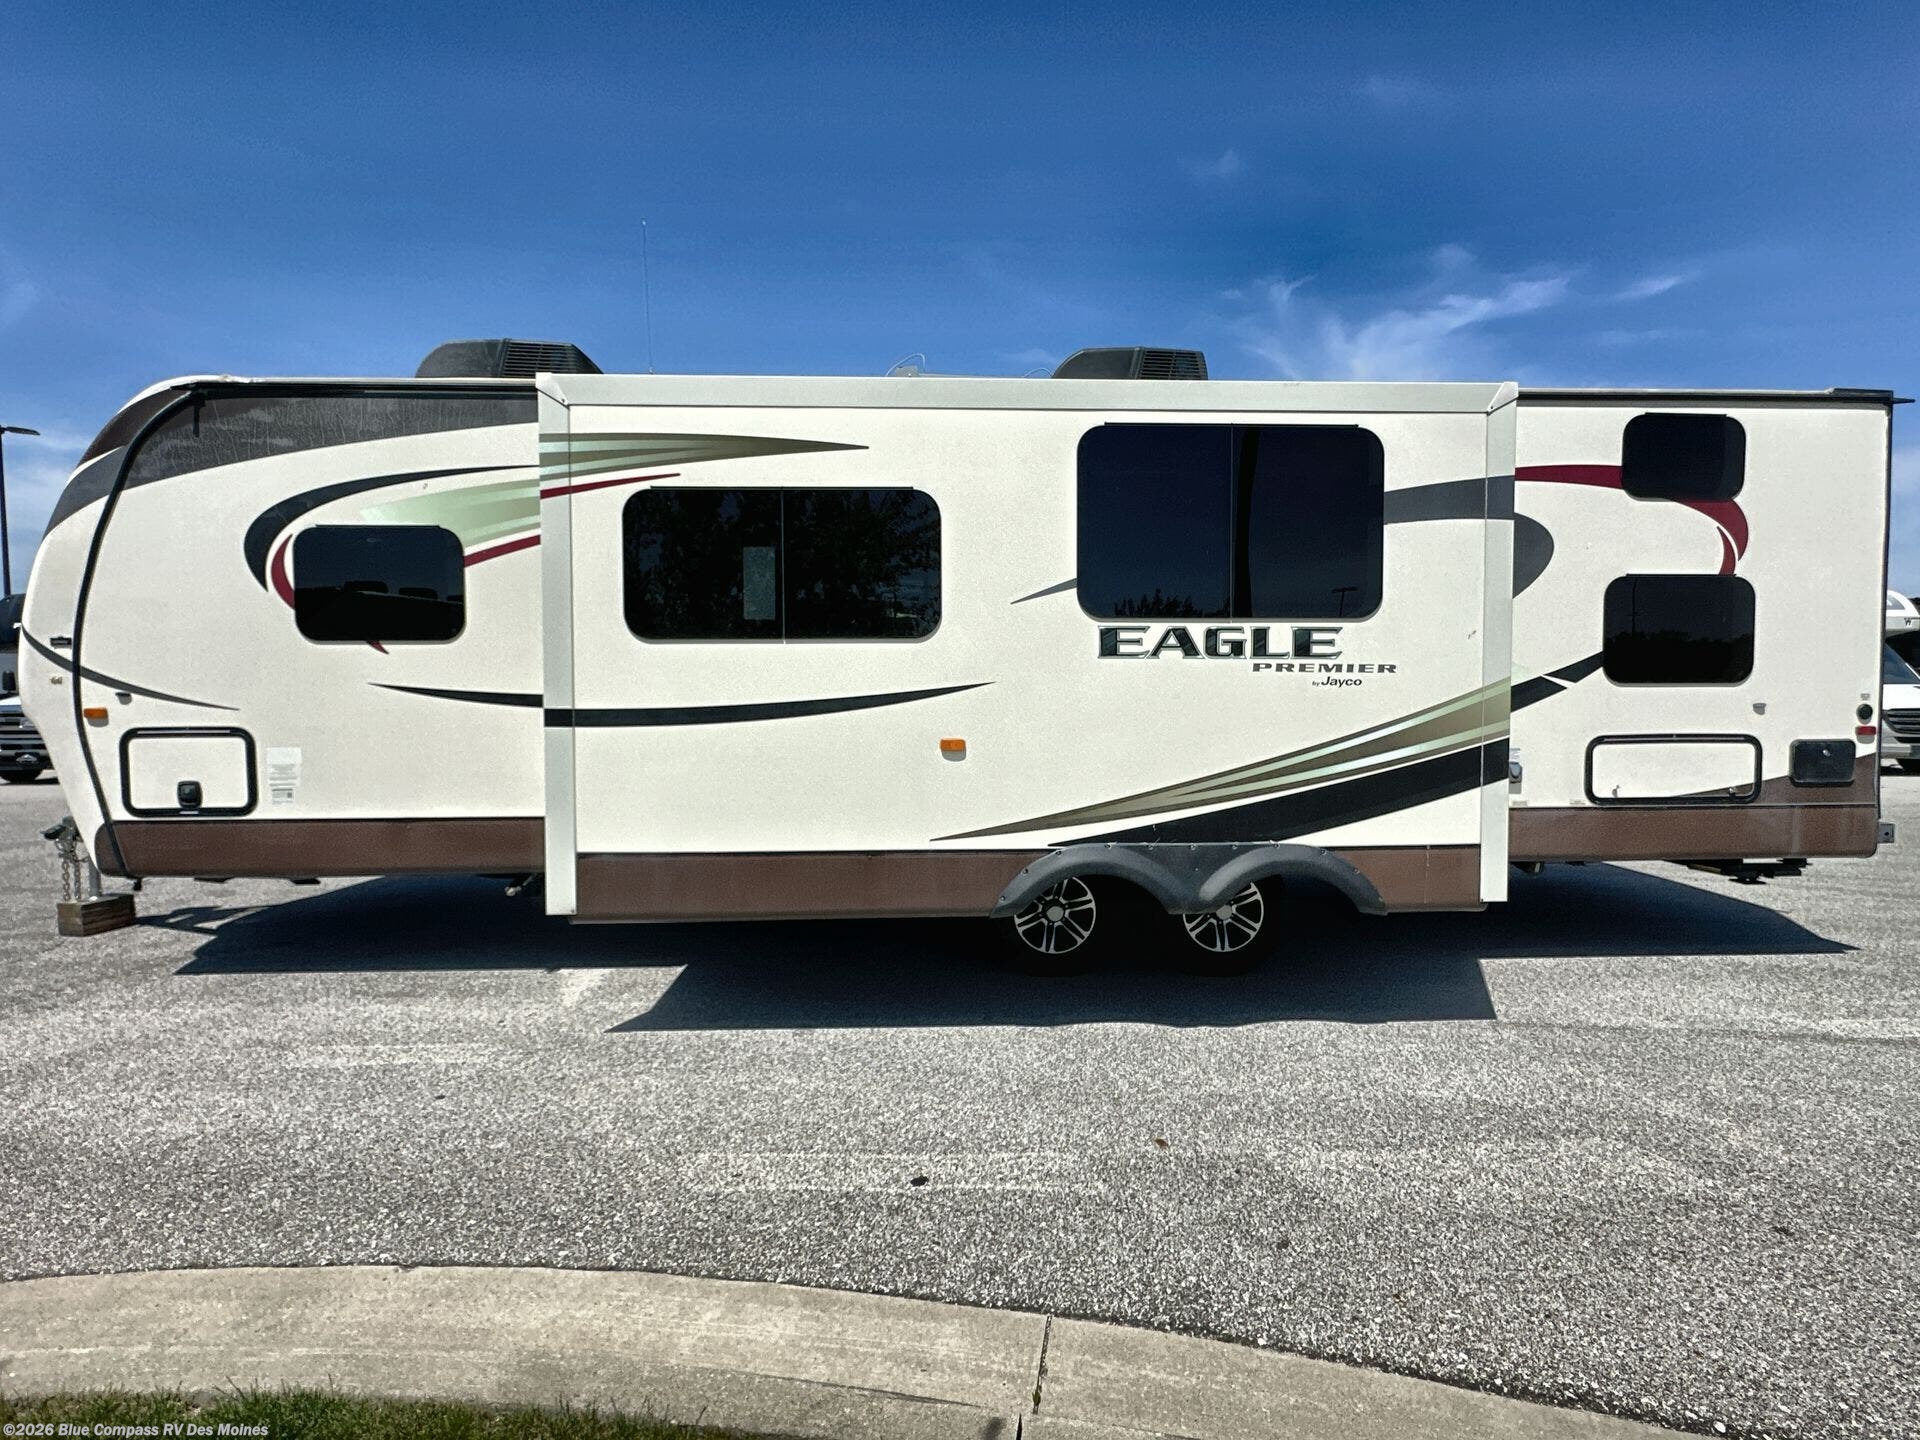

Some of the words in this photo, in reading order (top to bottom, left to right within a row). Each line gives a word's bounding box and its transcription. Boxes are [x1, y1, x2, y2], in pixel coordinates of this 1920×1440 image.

[1097, 625, 1343, 660] EAGLE
[1252, 663, 1397, 674] PREMIER
[1321, 676, 1362, 688] Jayco
